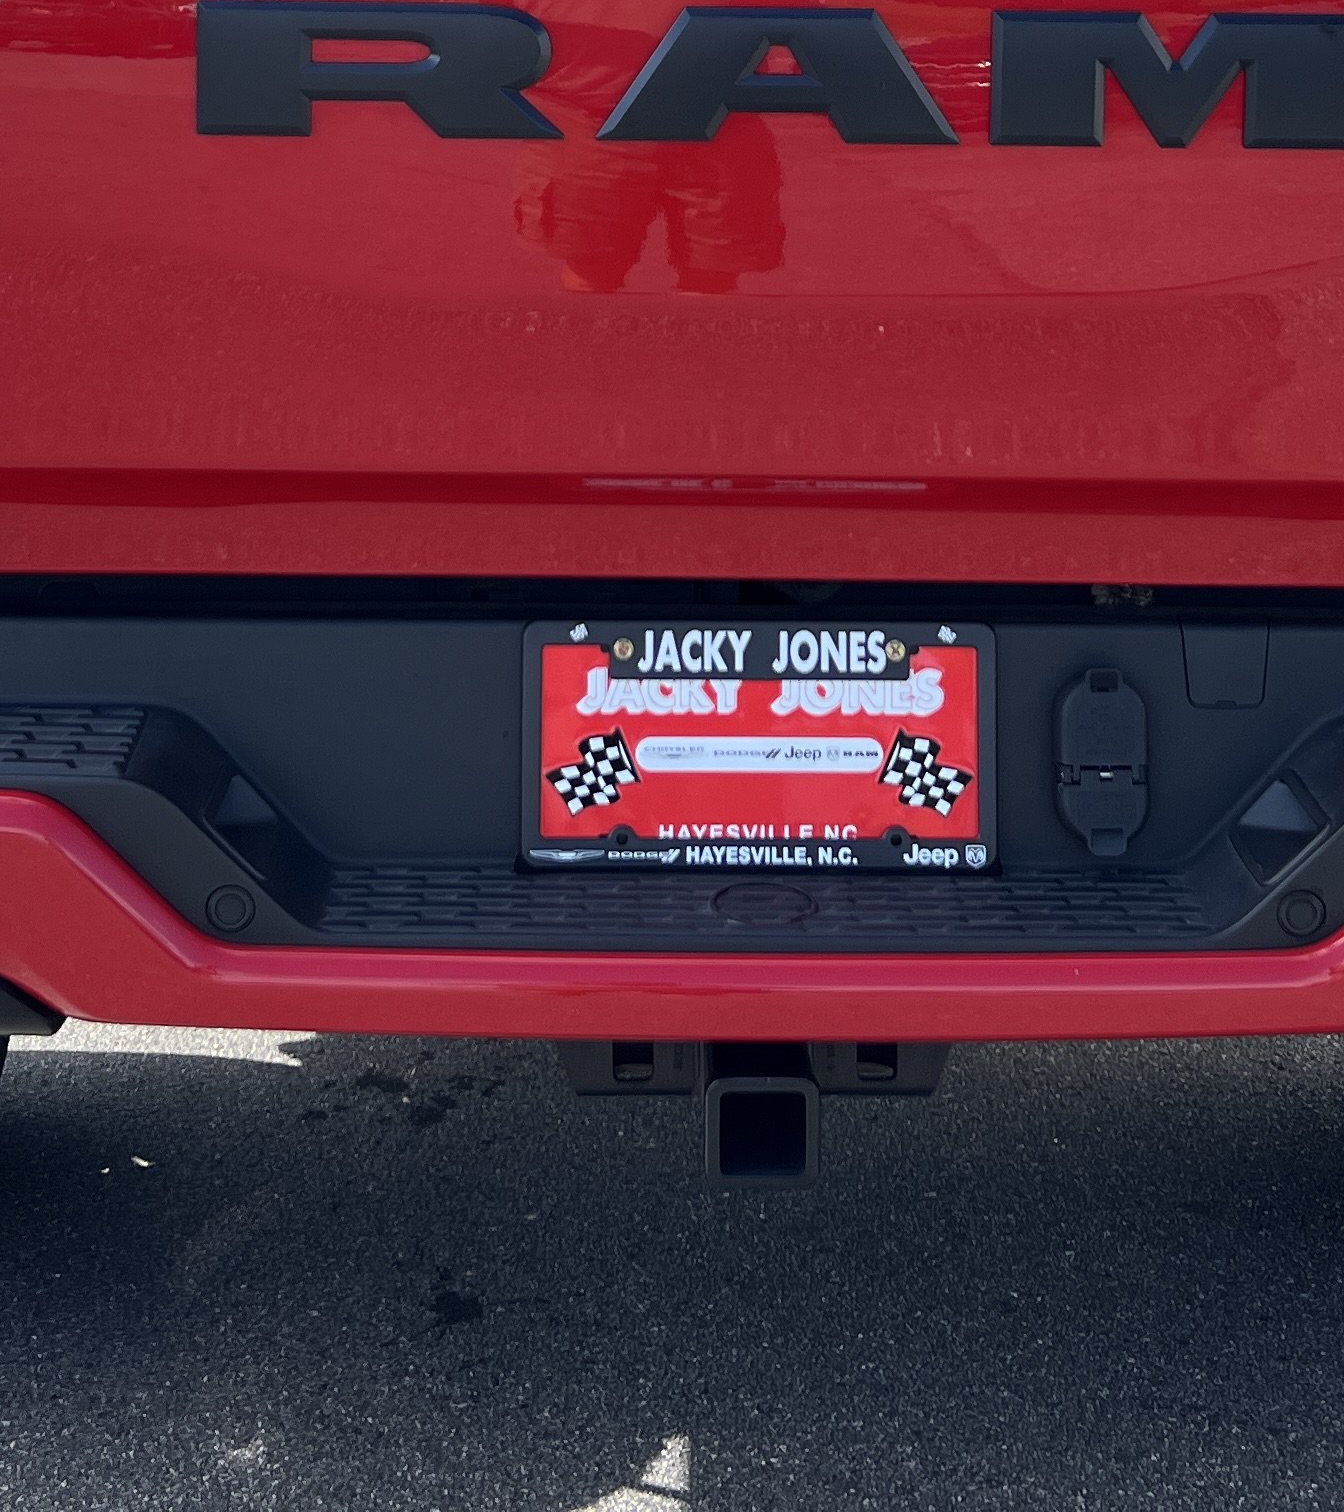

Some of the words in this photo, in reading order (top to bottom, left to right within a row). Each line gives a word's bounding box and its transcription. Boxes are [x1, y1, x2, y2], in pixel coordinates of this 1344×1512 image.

[637, 629, 752, 673] JACKY
[772, 630, 887, 673] JONES
[576, 666, 742, 715] JACKY
[771, 667, 944, 716] JONES
[784, 745, 822, 761] Jeep
[686, 845, 813, 866] HAYESVILLE,
[818, 846, 858, 865] N.C.
[903, 843, 959, 868] Jeep
